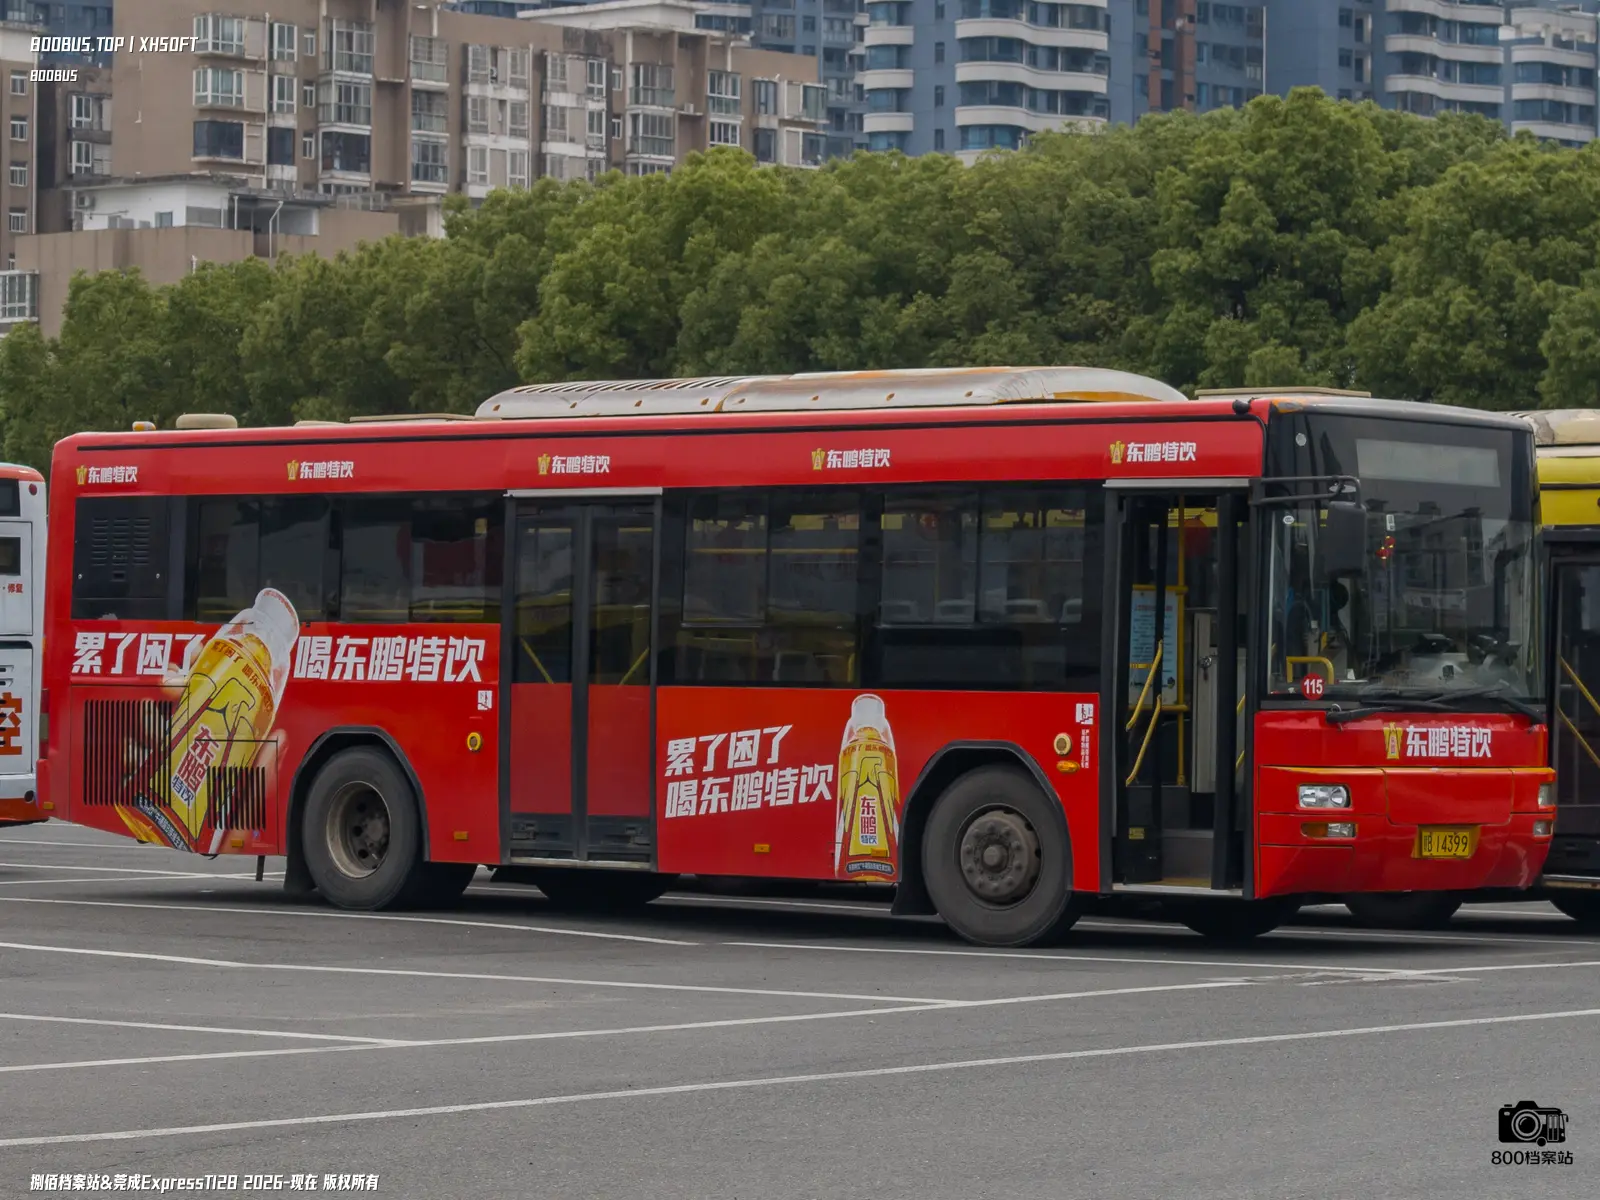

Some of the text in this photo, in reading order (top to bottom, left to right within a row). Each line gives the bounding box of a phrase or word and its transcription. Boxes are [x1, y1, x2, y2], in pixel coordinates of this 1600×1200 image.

[551, 454, 610, 474] 东鹏特饮
[826, 448, 891, 469] 东鹏特饮
[1126, 441, 1197, 463] 东鹏特饮
[88, 465, 138, 483] 东鹏特饮
[300, 460, 354, 479] 东鹏特饮
[71, 632, 486, 682] 累了困了 喝东鹏特饮
[1303, 678, 1324, 695] 115
[664, 724, 793, 777] 累了困了
[1406, 724, 1492, 758] 东鹏特饮
[176, 725, 220, 793] 东鹏
[665, 763, 834, 819] 喝东鹏特饮
[861, 796, 877, 835] 东鹏
